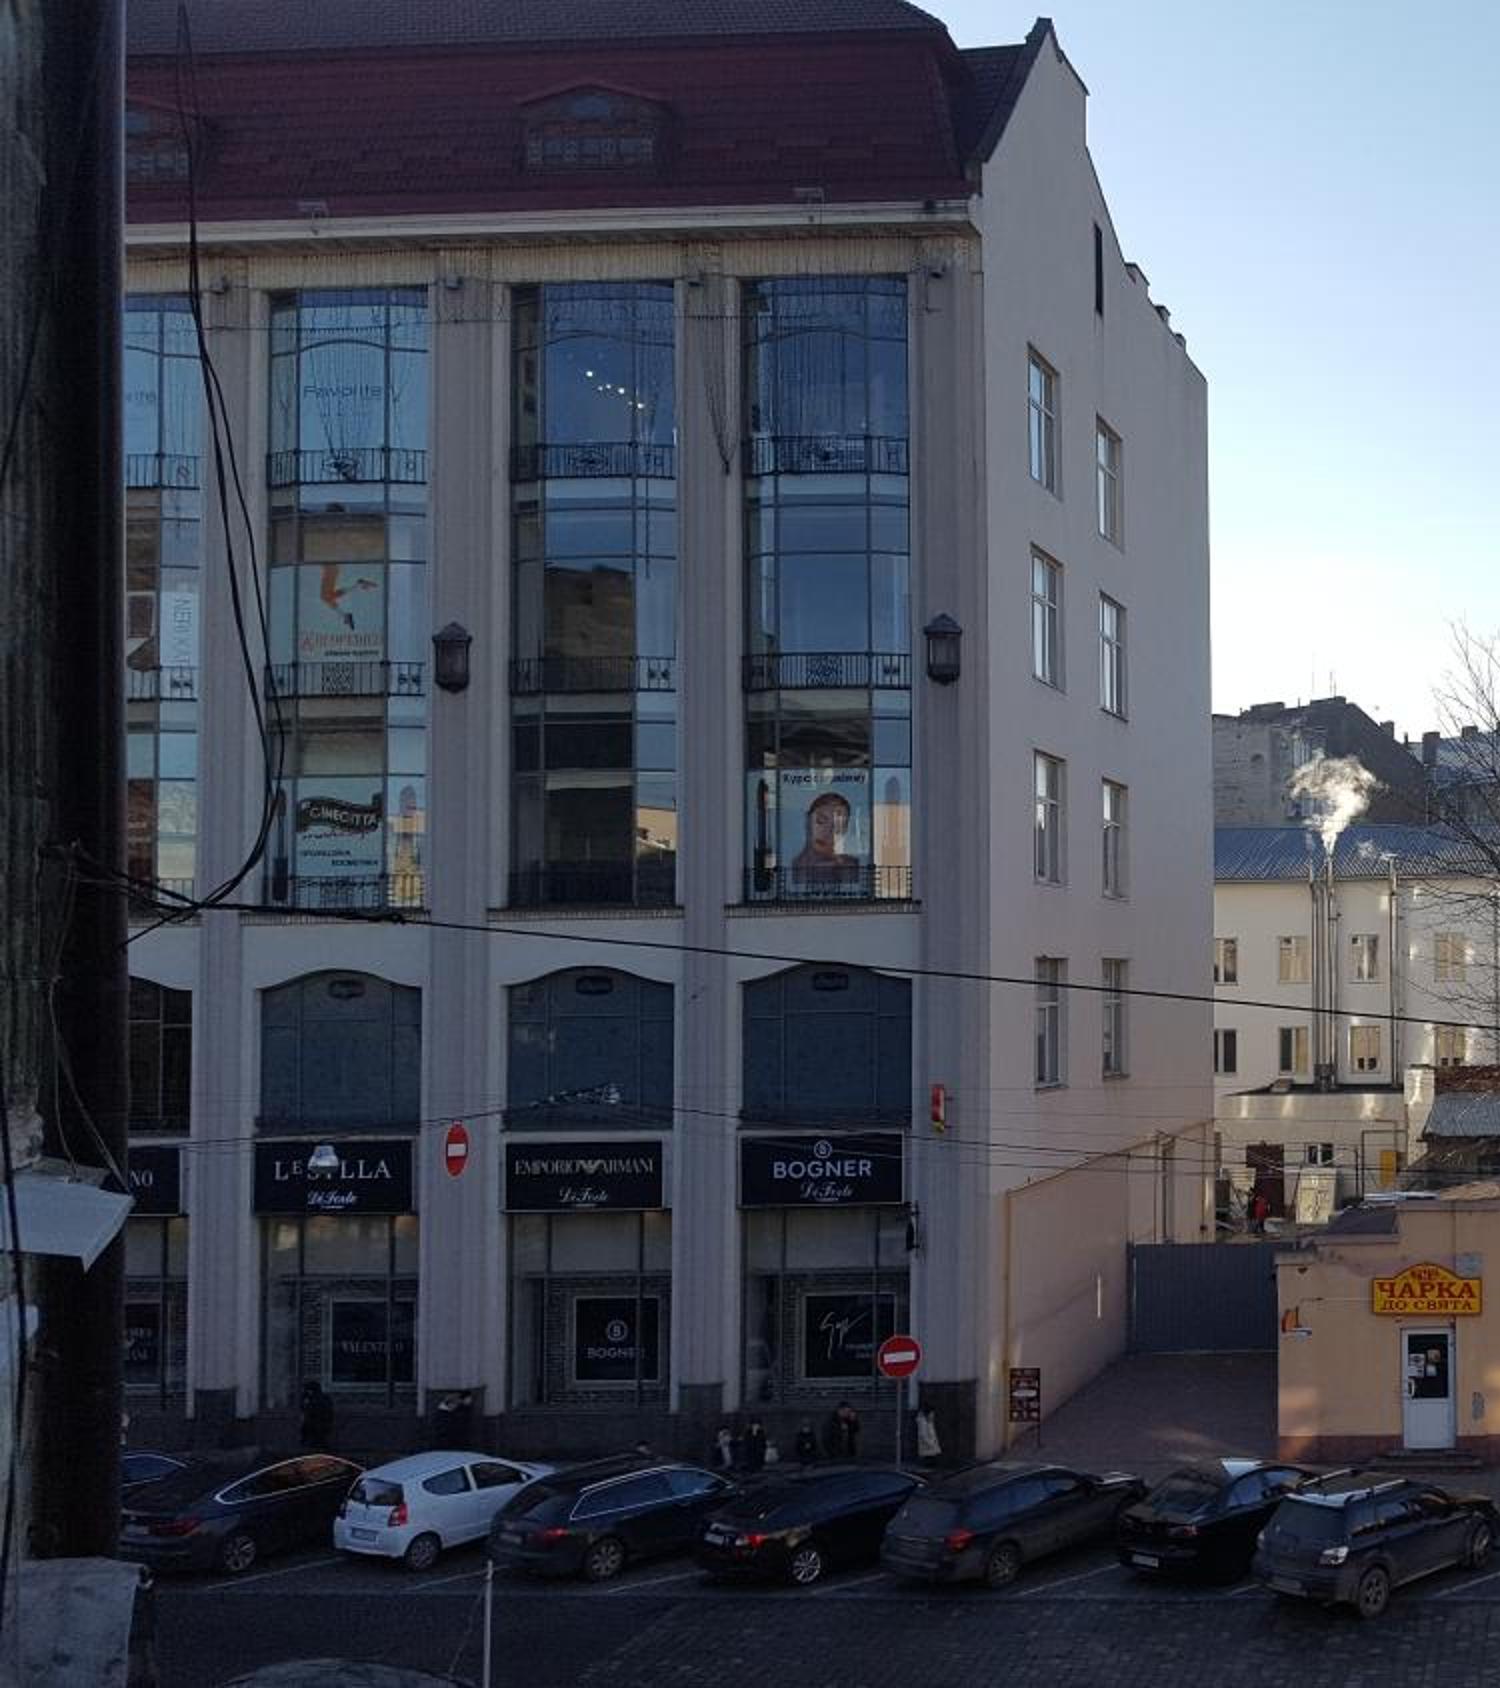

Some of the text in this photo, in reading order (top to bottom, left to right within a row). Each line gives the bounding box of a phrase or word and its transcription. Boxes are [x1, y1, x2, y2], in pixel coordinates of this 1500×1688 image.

[773, 1159, 872, 1179] BOGNER
[1375, 1281, 1476, 1299] ЧАРКА
[1382, 1301, 1408, 1311] ДО
